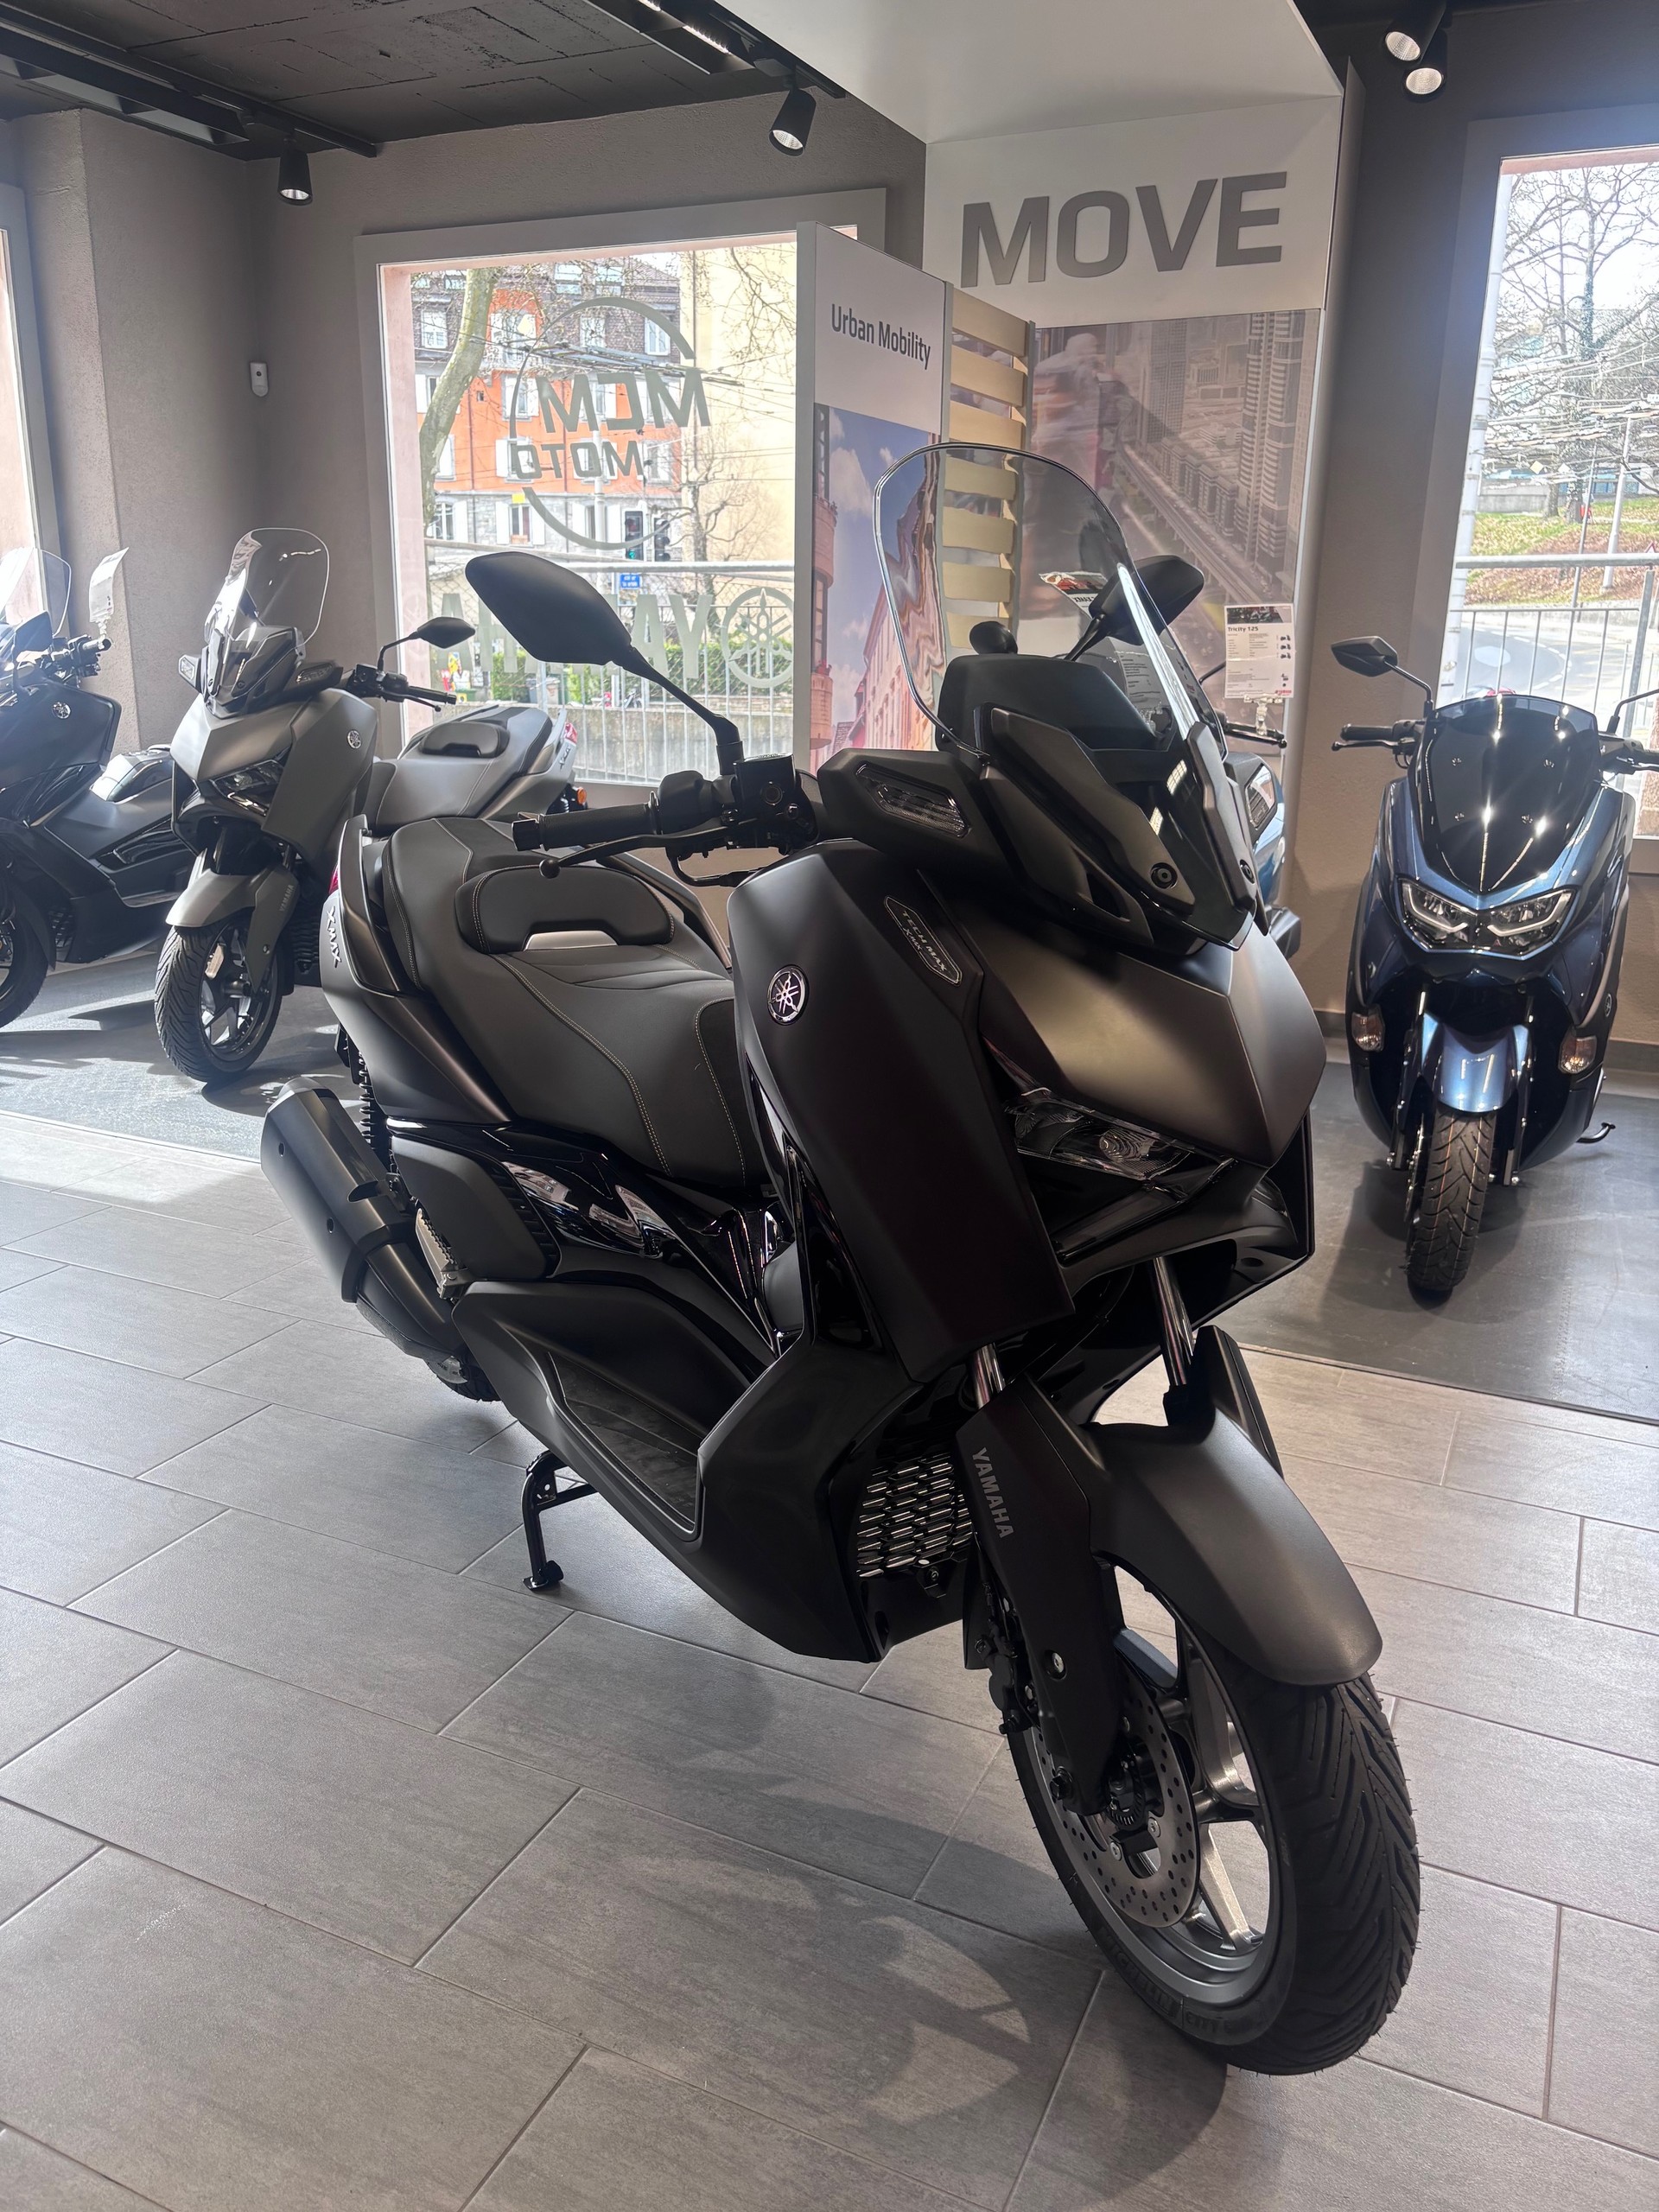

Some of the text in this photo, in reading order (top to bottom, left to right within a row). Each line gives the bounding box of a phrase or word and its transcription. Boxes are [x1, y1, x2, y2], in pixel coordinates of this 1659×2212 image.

[960, 171, 1287, 289] MOVE
[831, 303, 931, 370] Urban Mobility
[327, 906, 342, 969] XMAX
[902, 910, 947, 971] TECH MAX
[972, 1446, 1014, 1539] YAMAHA
